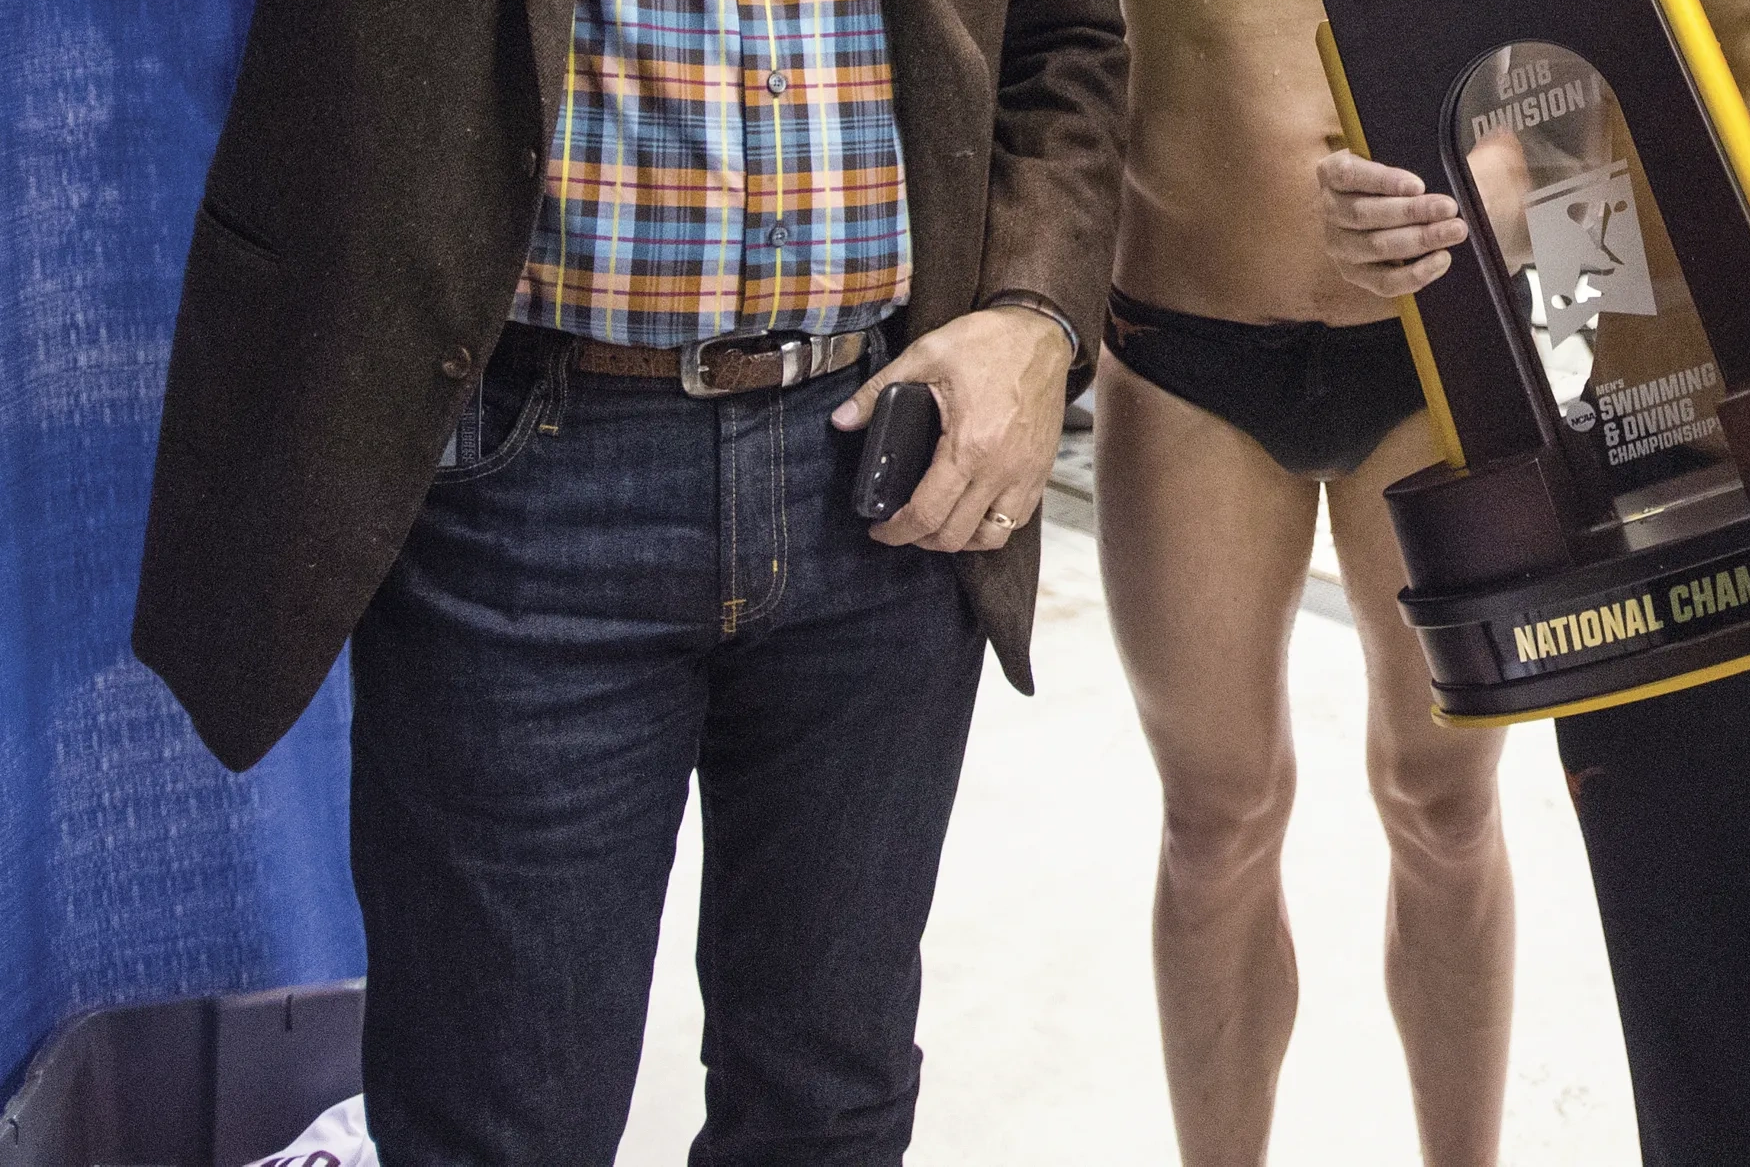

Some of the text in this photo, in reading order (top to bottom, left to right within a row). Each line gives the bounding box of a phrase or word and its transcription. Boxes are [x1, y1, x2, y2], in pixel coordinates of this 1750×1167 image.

[1497, 59, 1552, 101] 2018
[1471, 79, 1586, 142] DIVISION
[1595, 378, 1625, 397] MEN'S
[1599, 362, 1717, 421] SWIMMING
[1571, 412, 1595, 427] NCAA
[1603, 397, 1695, 448] & DIVING
[1513, 594, 1664, 663] NATIONAL
